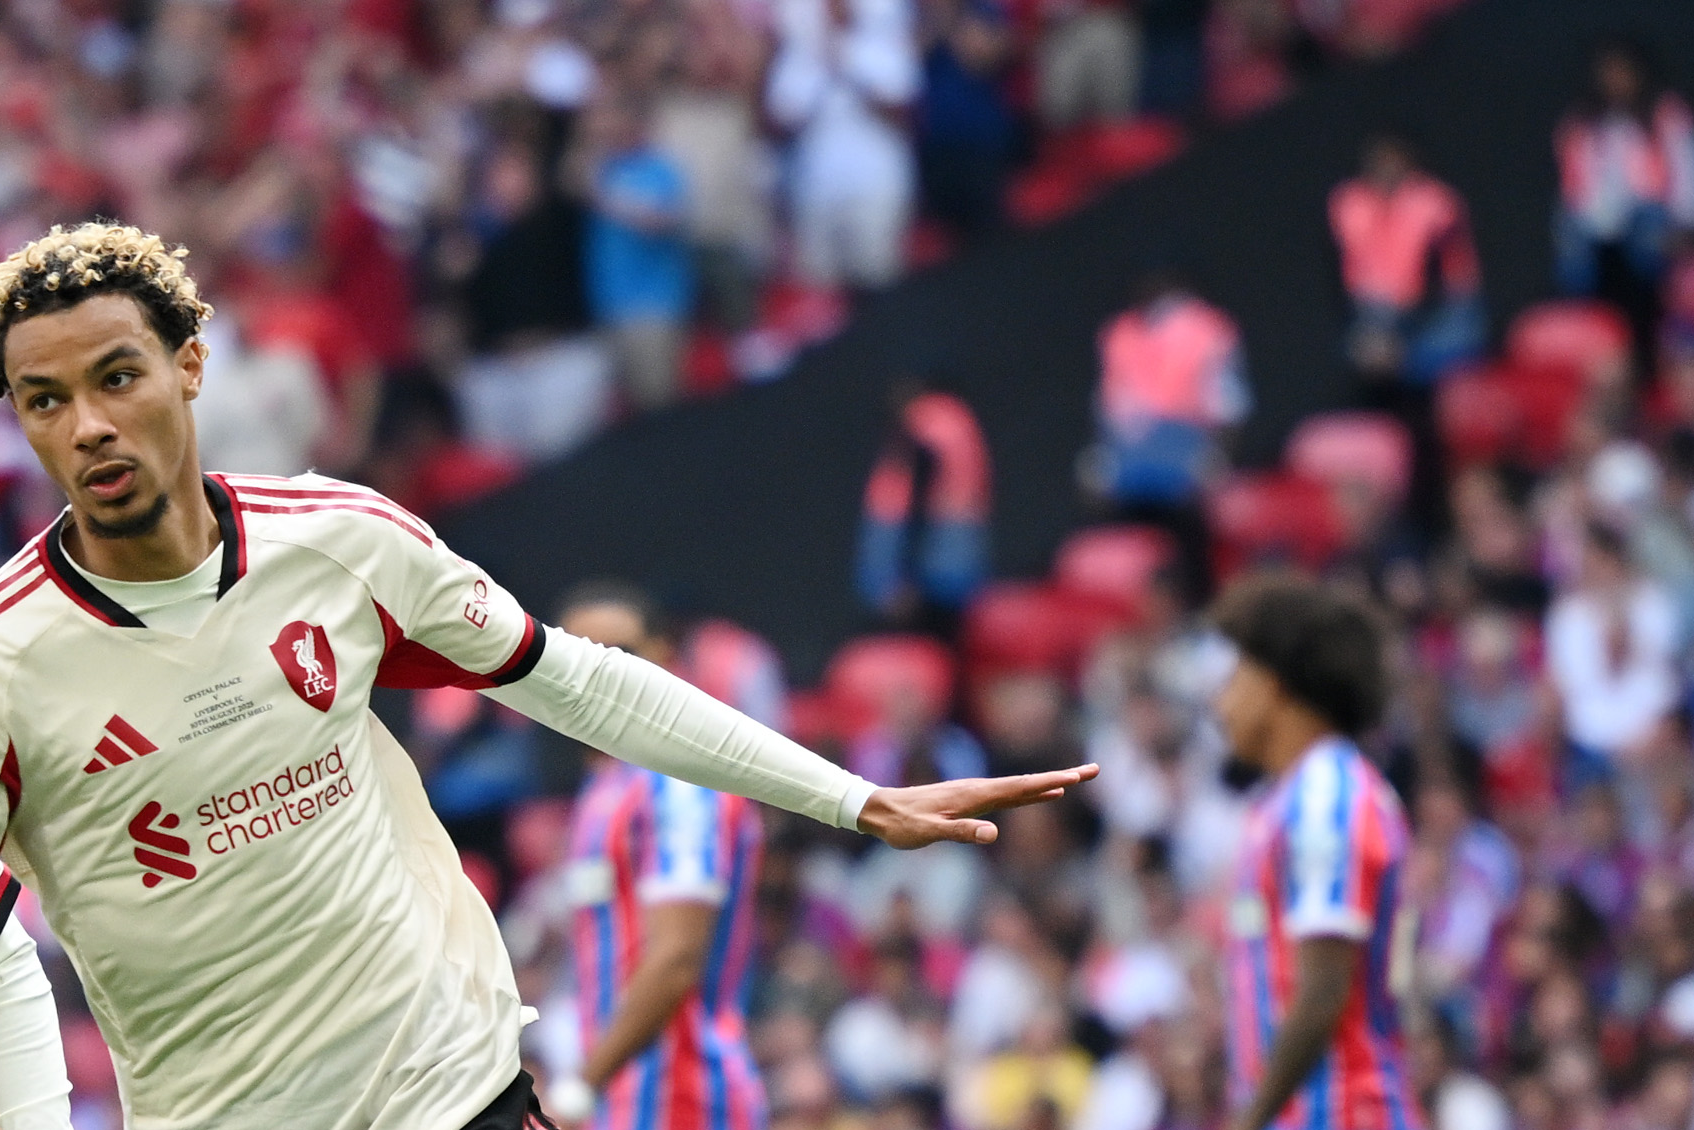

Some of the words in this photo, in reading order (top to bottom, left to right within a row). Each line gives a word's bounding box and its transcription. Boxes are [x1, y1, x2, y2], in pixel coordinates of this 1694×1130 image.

[183, 687, 214, 703] CRYSTAL
[214, 676, 242, 691] PALACE
[194, 699, 234, 718] LIVERPOOL
[234, 694, 244, 704] FC
[178, 732, 193, 744] THE
[193, 730, 203, 738] FA
[202, 713, 247, 735] COMMUNITY
[247, 703, 273, 719] SHIELD
[209, 708, 237, 722] AUGUST
[196, 743, 345, 827] standard
[206, 774, 354, 855] chartered
